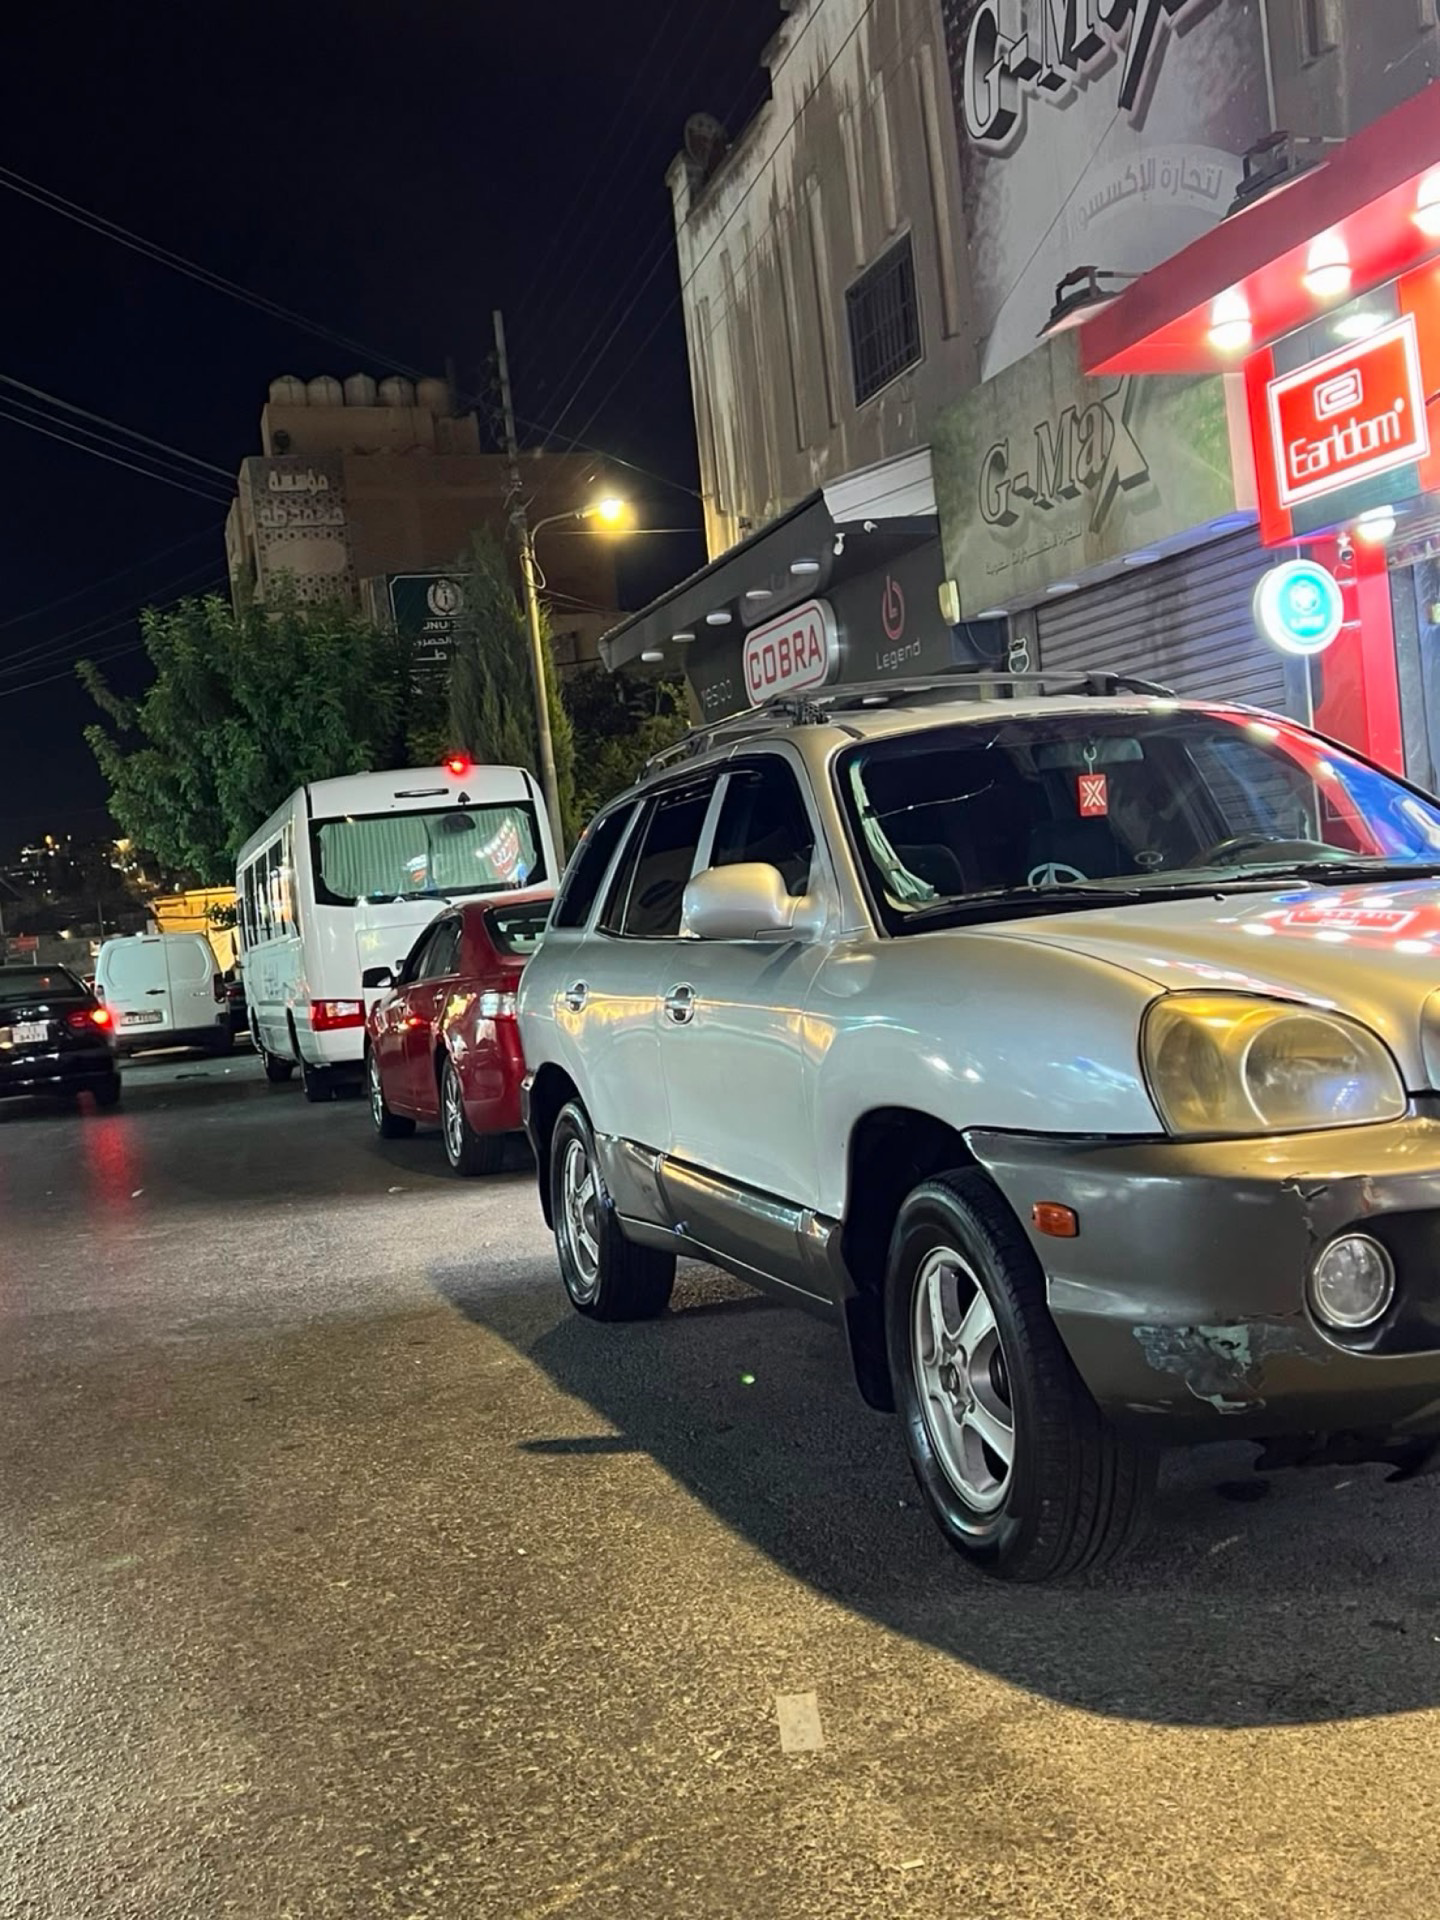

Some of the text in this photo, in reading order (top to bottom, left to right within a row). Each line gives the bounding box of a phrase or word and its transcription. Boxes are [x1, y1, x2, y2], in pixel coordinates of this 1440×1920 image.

[1160, 156, 1223, 200] لتجارة
[1289, 411, 1402, 479] Earldom
[749, 624, 823, 691] COBRA
[876, 637, 922, 671] Legend
